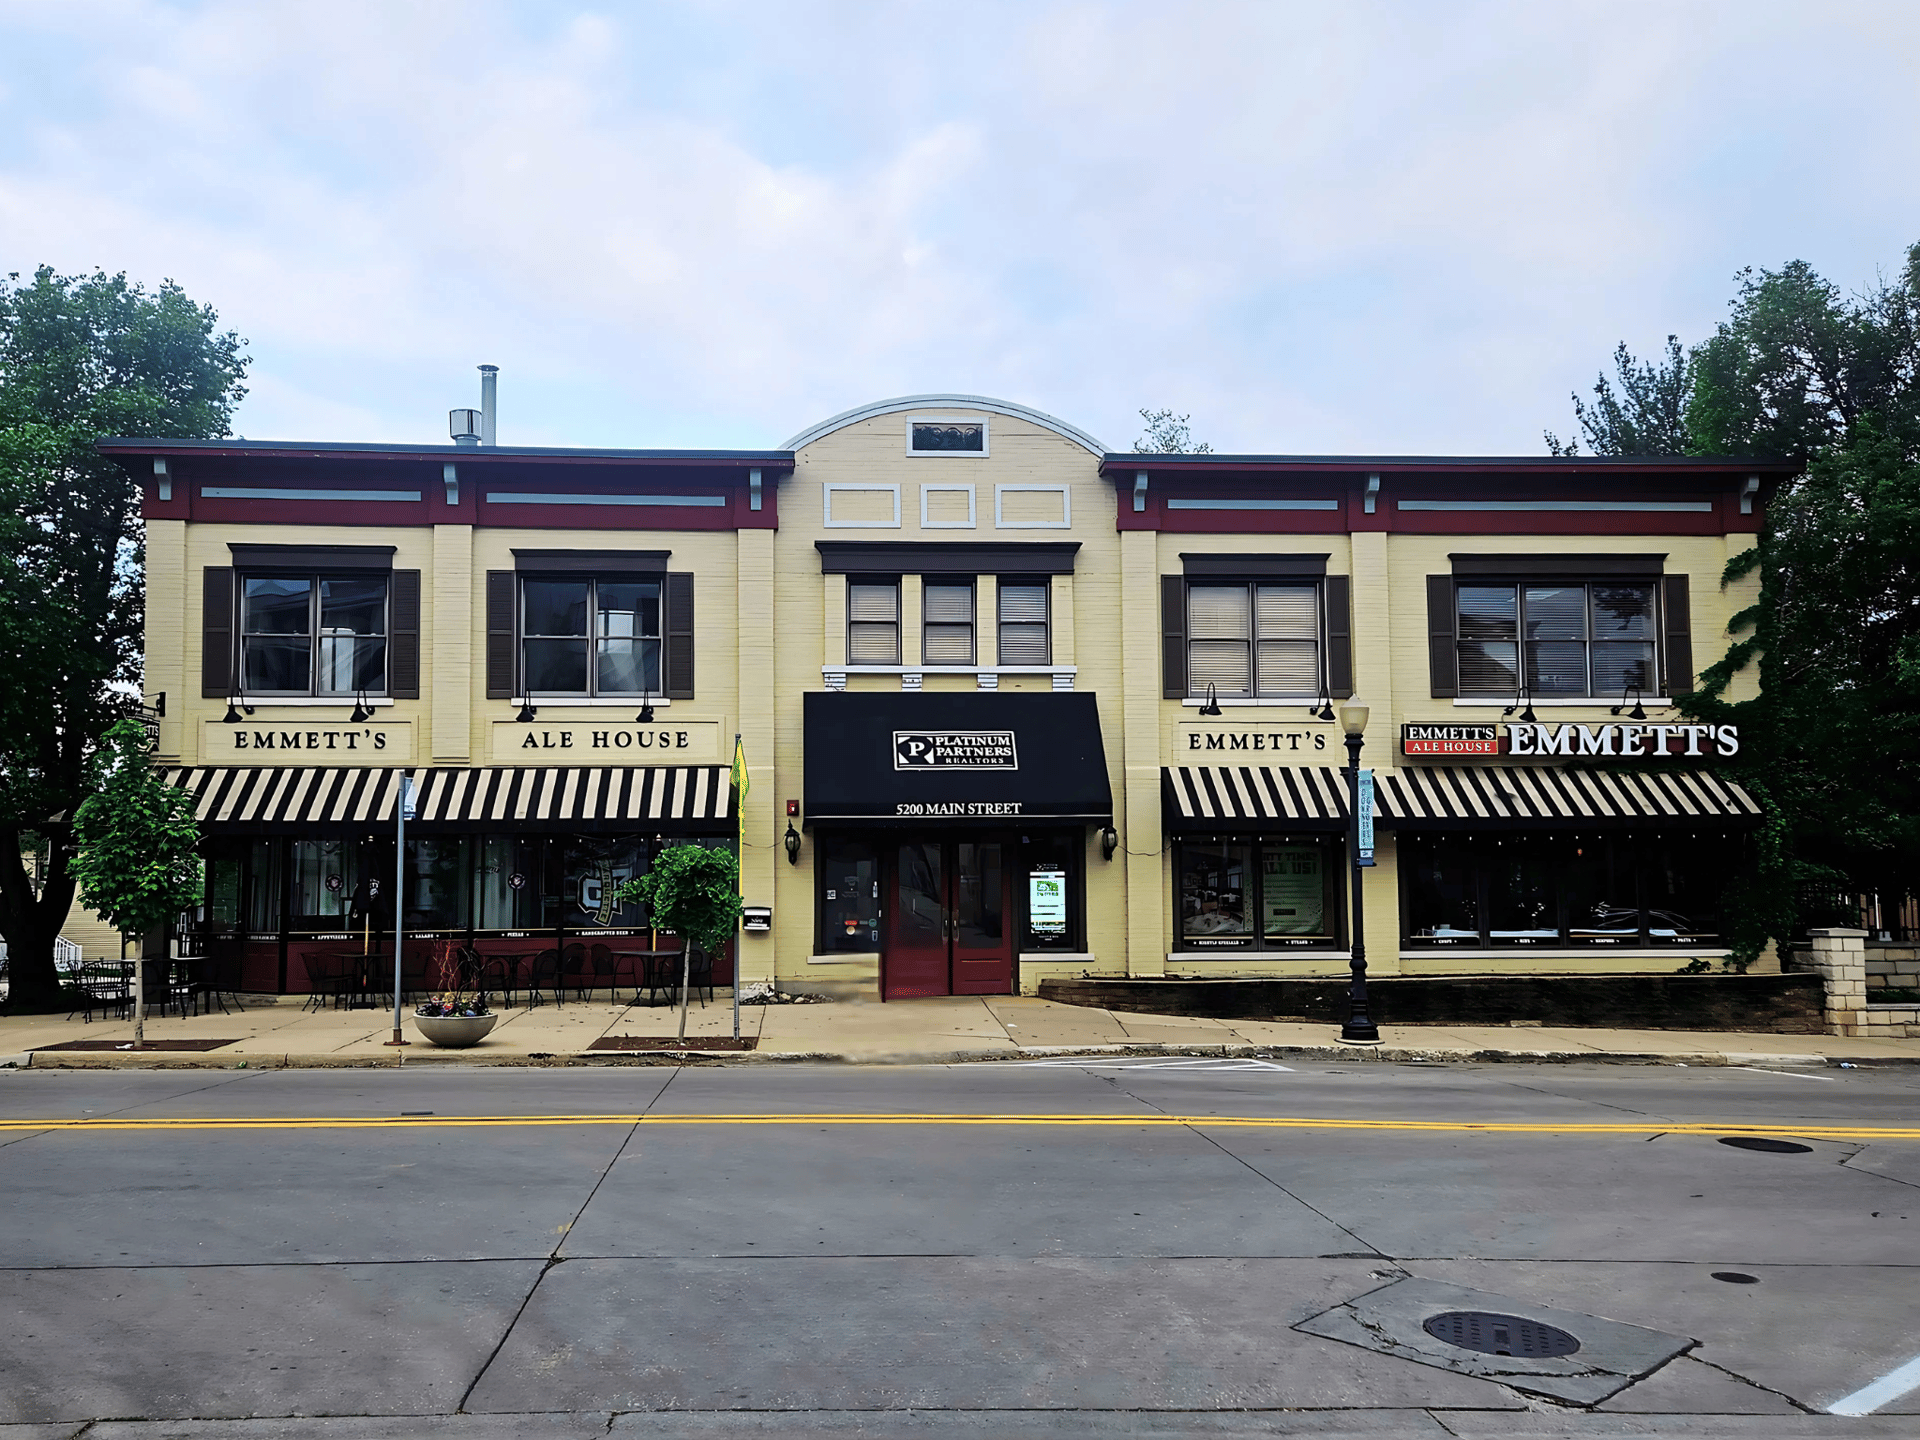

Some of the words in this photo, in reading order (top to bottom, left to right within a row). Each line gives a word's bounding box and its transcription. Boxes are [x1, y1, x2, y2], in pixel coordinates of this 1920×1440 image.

[234, 728, 386, 750] EMMETT'S
[521, 731, 573, 748] ALE
[592, 731, 689, 748] HOUSE
[1409, 727, 1494, 739] EMMETT'S
[935, 736, 1011, 746] PLATINUM
[1188, 731, 1326, 750] EMMETT'S
[1506, 724, 1739, 756] EMMETT'S
[936, 747, 1012, 757] PARTNERS
[1412, 742, 1440, 752] ALE
[1444, 742, 1492, 752] HOUSE
[896, 804, 923, 815] 5200
[925, 803, 965, 815] MAIN
[967, 802, 1022, 815] STREET
